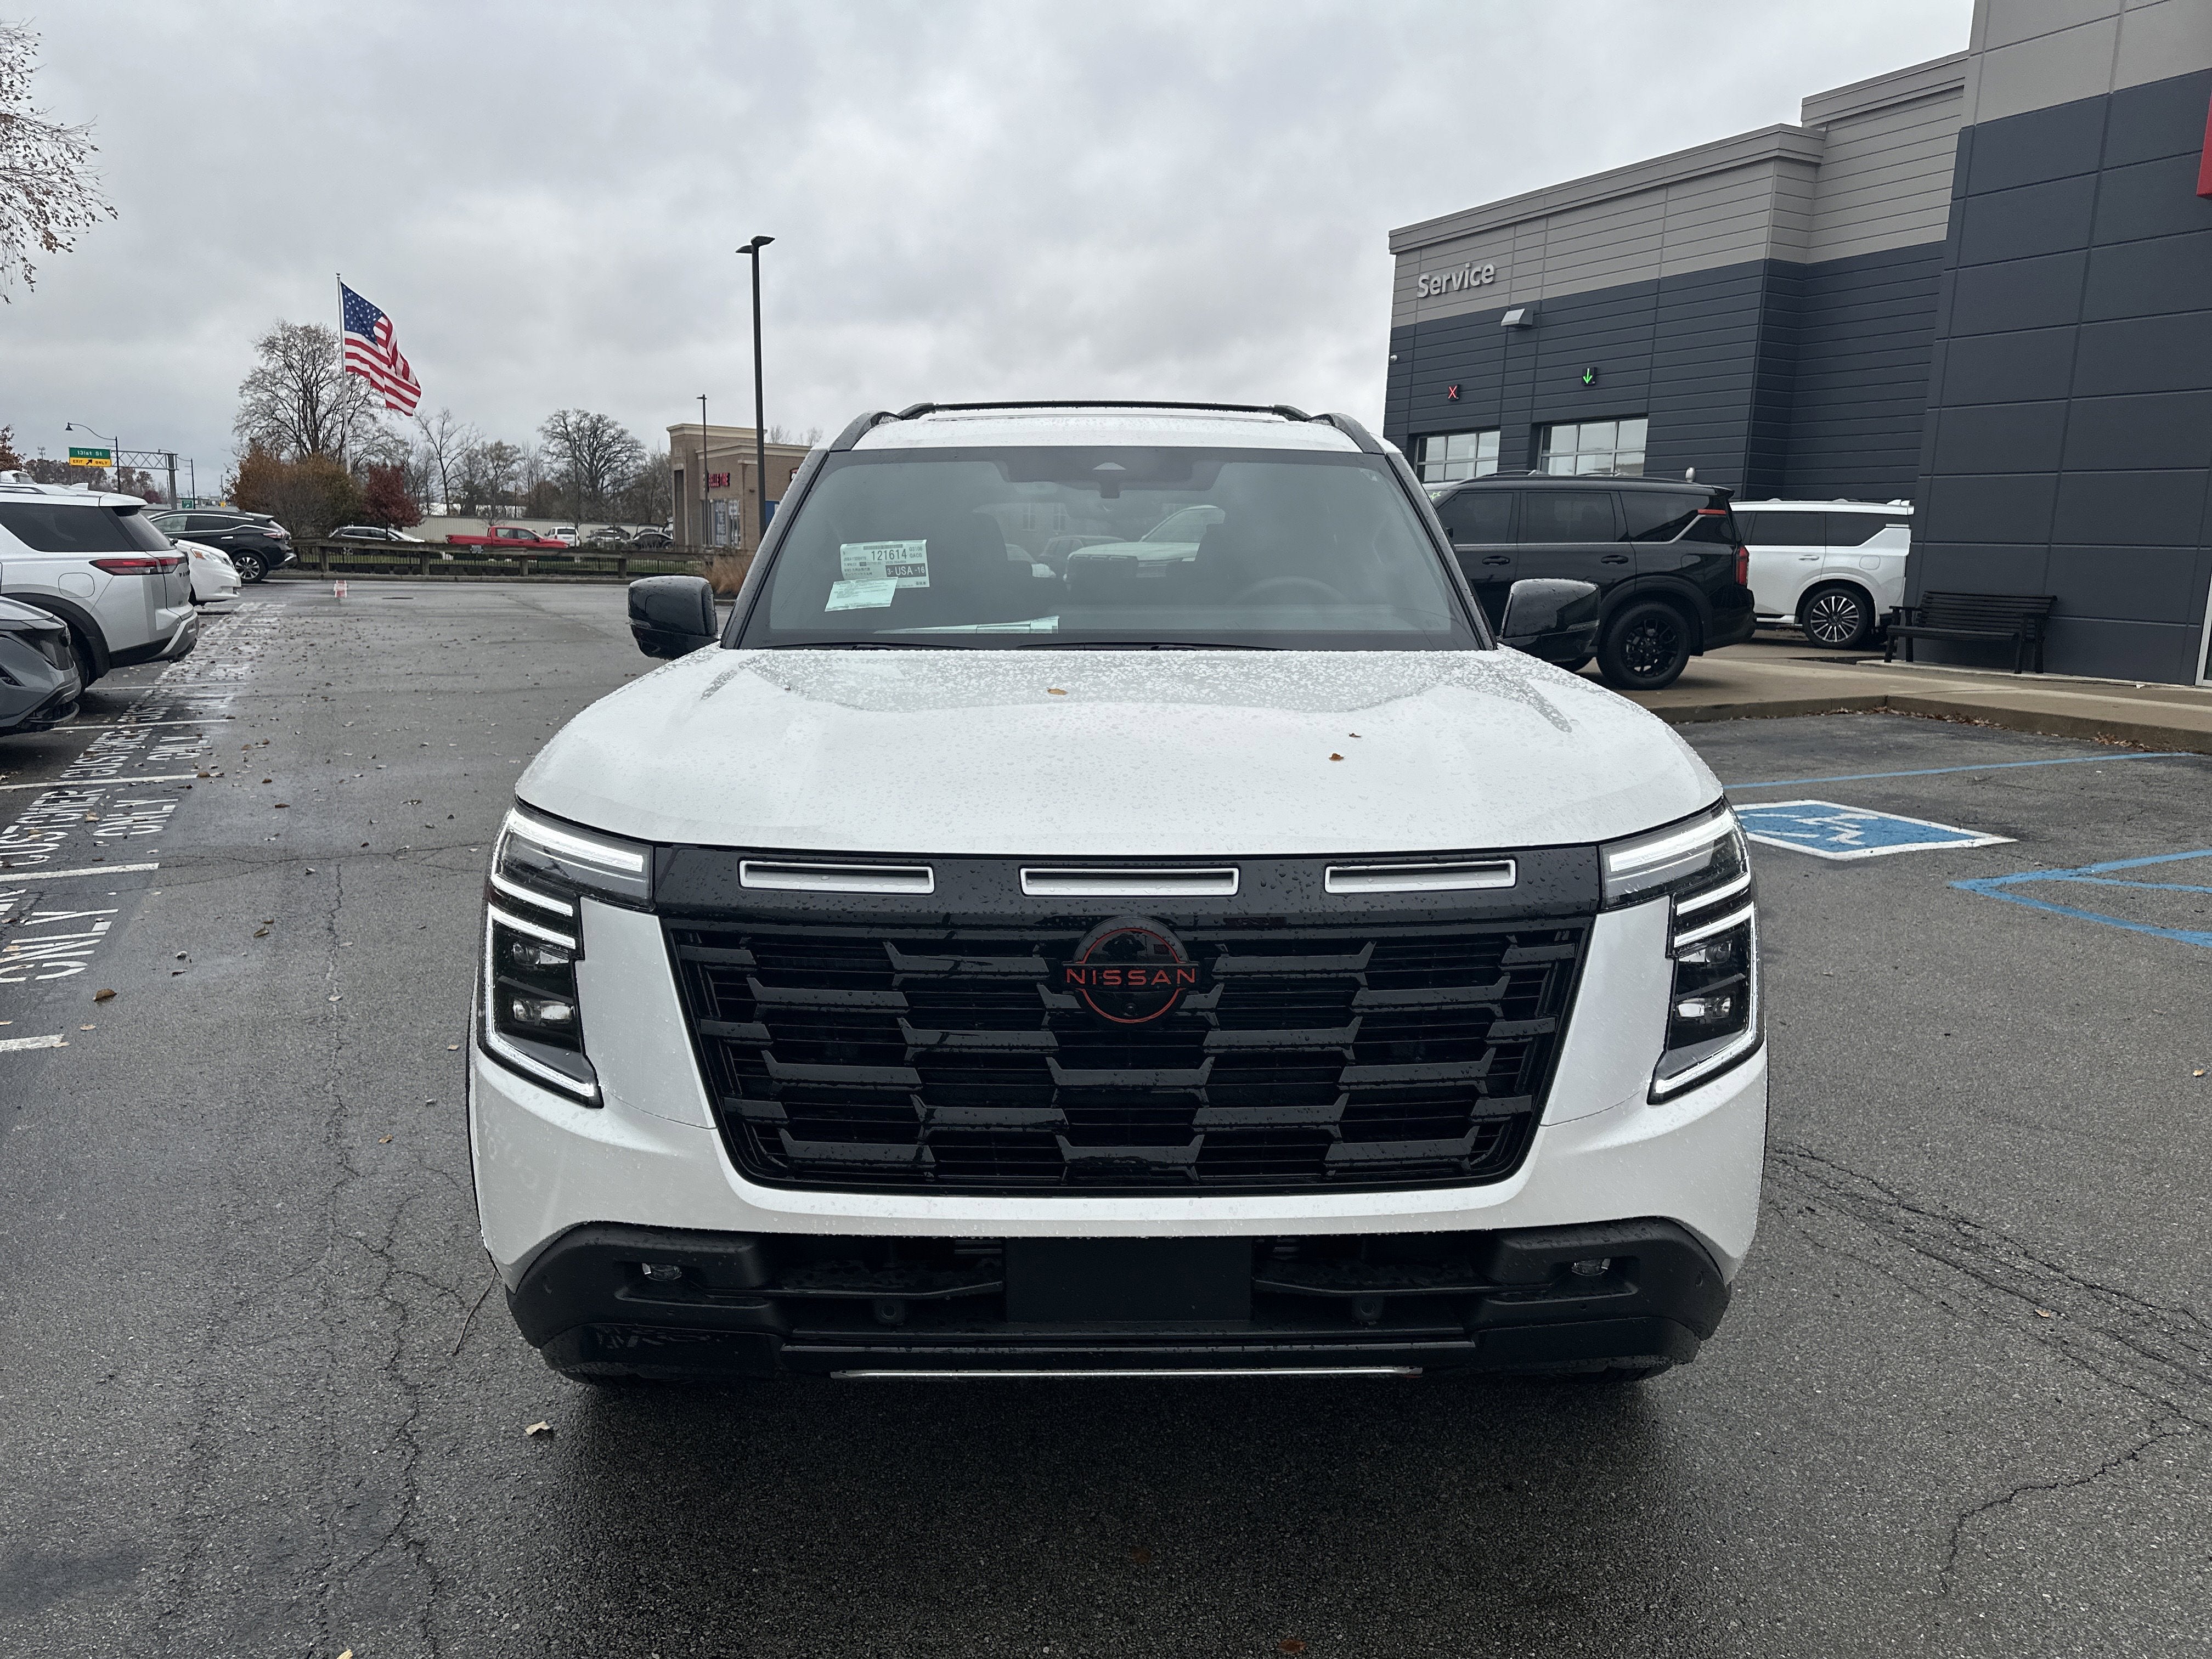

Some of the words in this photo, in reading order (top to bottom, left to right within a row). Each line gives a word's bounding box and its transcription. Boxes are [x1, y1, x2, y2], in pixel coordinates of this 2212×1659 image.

[1417, 262, 1495, 298] Service
[871, 549, 907, 561] 121614
[895, 566, 913, 575] USA
[60, 728, 153, 777] CUSTOMER
[146, 736, 210, 760] ONLY
[93, 799, 179, 837] ONLY
[0, 909, 119, 983] ONLY
[1066, 968, 1195, 985] NISSAN
